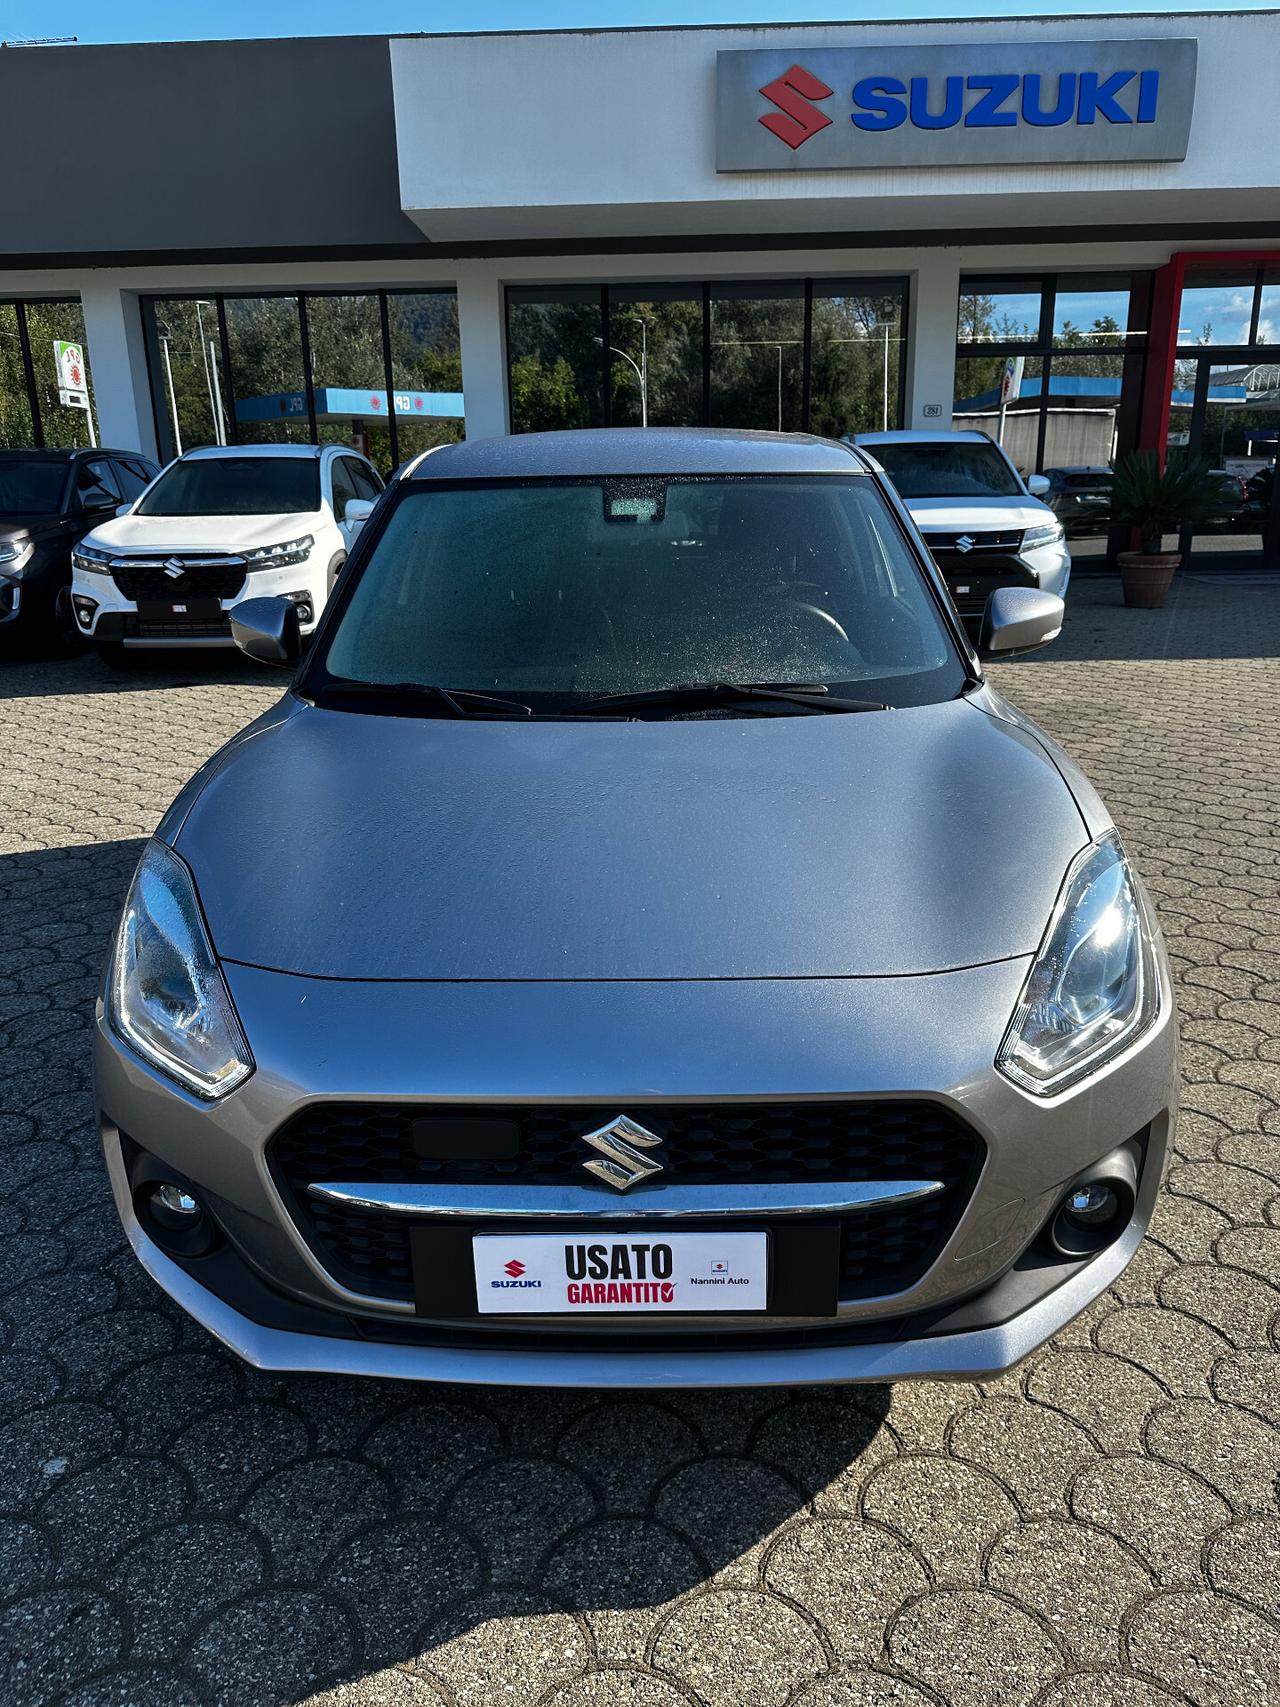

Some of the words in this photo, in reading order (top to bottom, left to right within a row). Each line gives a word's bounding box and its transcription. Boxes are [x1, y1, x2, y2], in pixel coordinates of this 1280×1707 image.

[851, 70, 1160, 132] SUZUKI
[564, 1243, 673, 1281] USATO
[491, 1280, 542, 1288] SUZUKI
[690, 1277, 725, 1285] Nannini
[727, 1277, 750, 1285] Auto
[567, 1282, 677, 1304] GARANTITO
